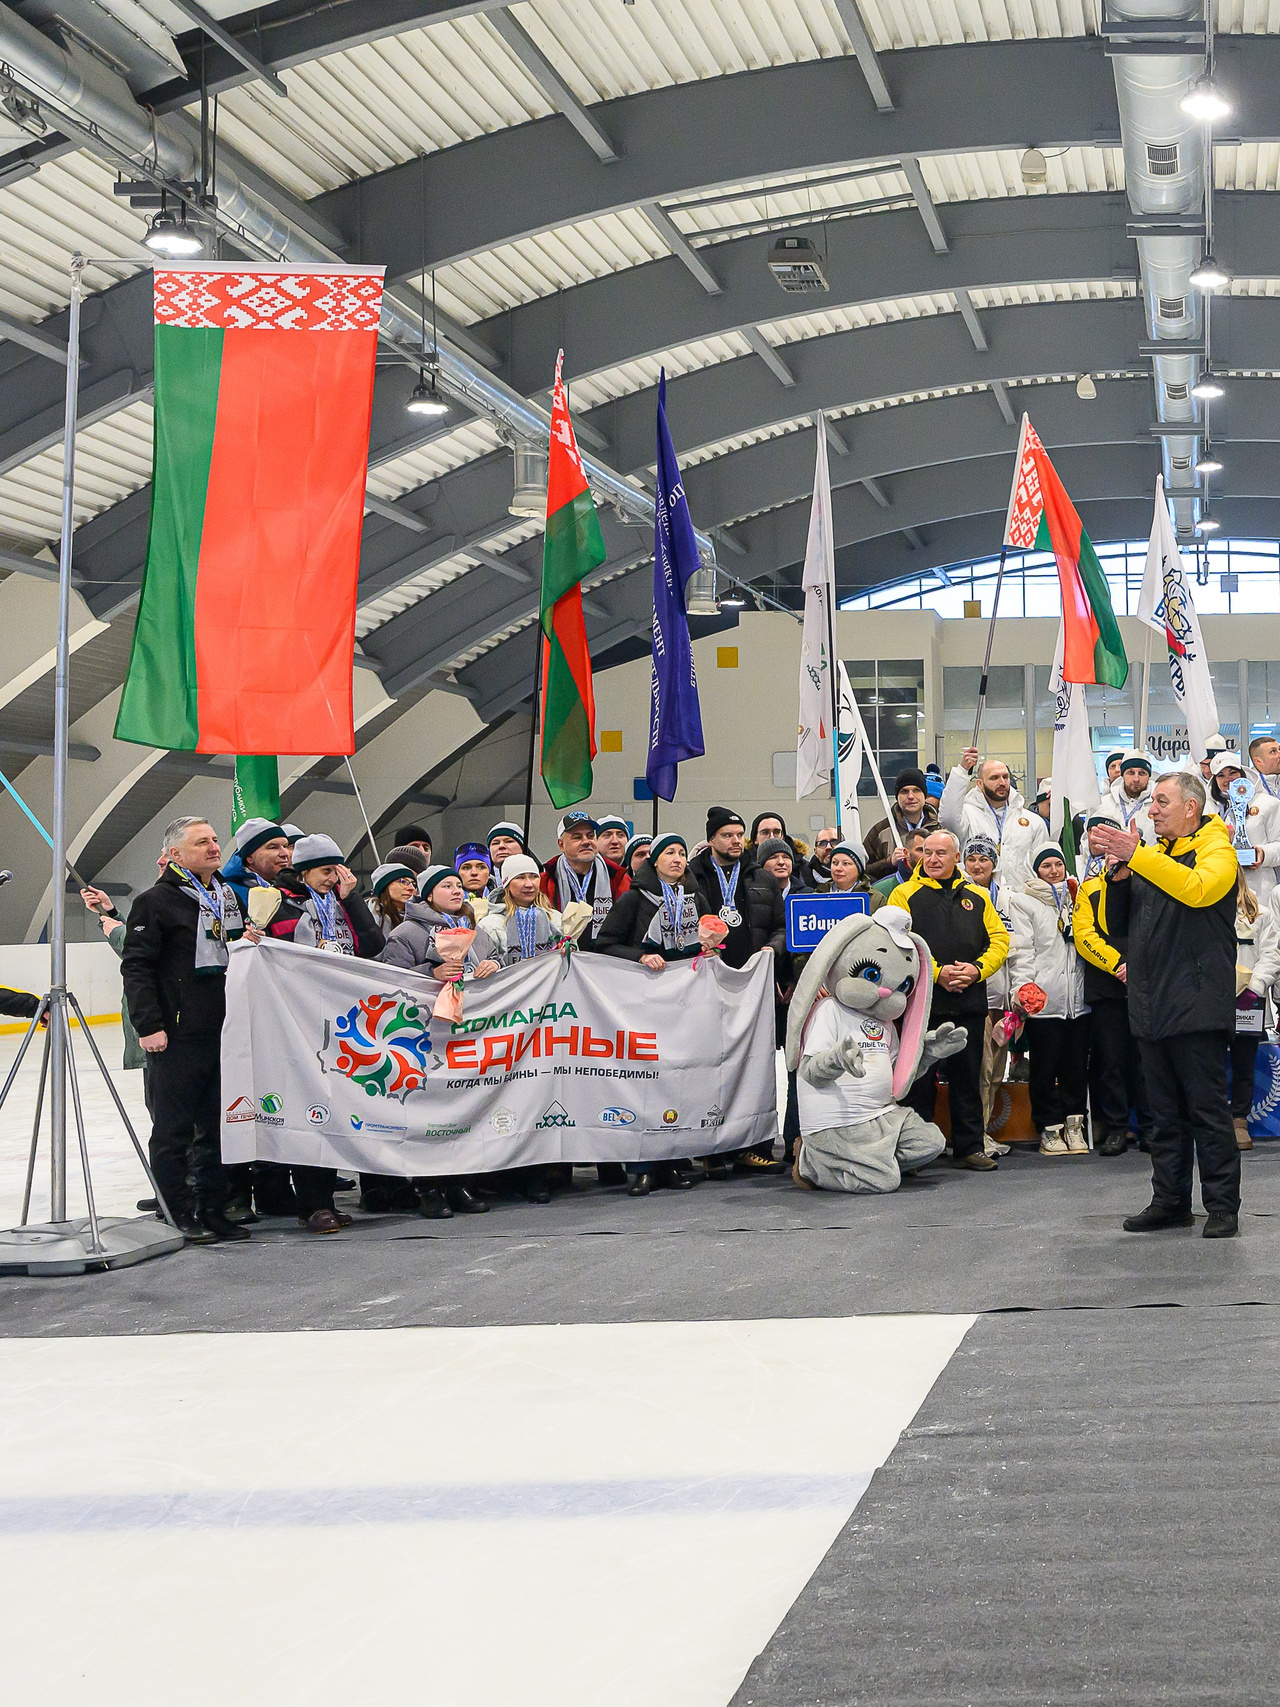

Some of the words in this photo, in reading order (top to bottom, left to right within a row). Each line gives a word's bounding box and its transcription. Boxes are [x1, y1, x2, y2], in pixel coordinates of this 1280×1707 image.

[798, 914, 841, 932] Един
[1082, 939, 1108, 965] BELARUS
[450, 1002, 579, 1035] КОМАНДА
[445, 1025, 660, 1076] ЕДИНЫЕ
[446, 1077, 481, 1090] КОГДА
[483, 1075, 503, 1086] МЫ
[503, 1068, 538, 1084] ЕДИНЫ
[553, 1066, 572, 1076] МЫ
[574, 1066, 660, 1080] НЕПОБЕДИМЫ!
